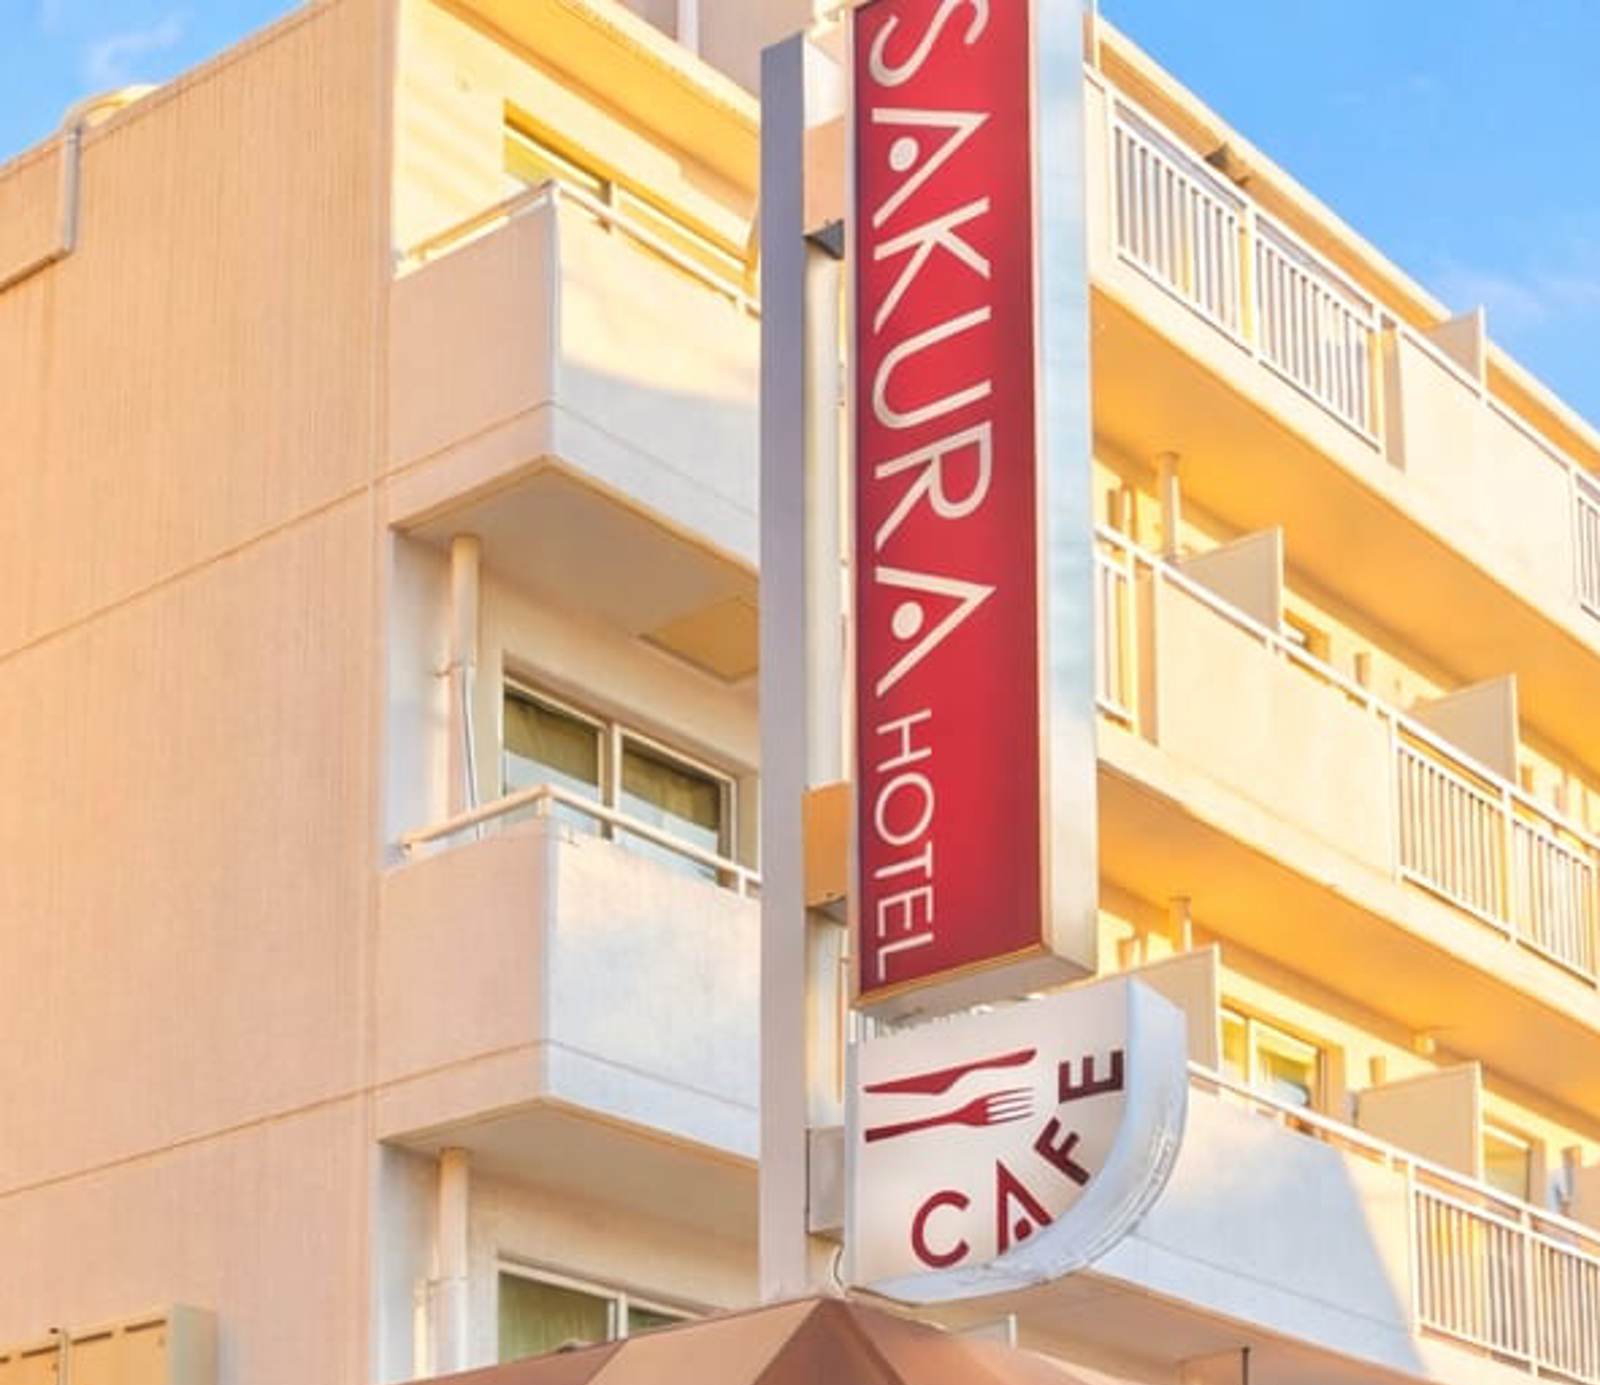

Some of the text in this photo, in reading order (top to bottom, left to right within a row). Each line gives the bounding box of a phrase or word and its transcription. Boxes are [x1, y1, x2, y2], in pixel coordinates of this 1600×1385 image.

[868, 0, 995, 981] SAKURA HOTEL
[911, 1049, 1125, 1269] CAFE
